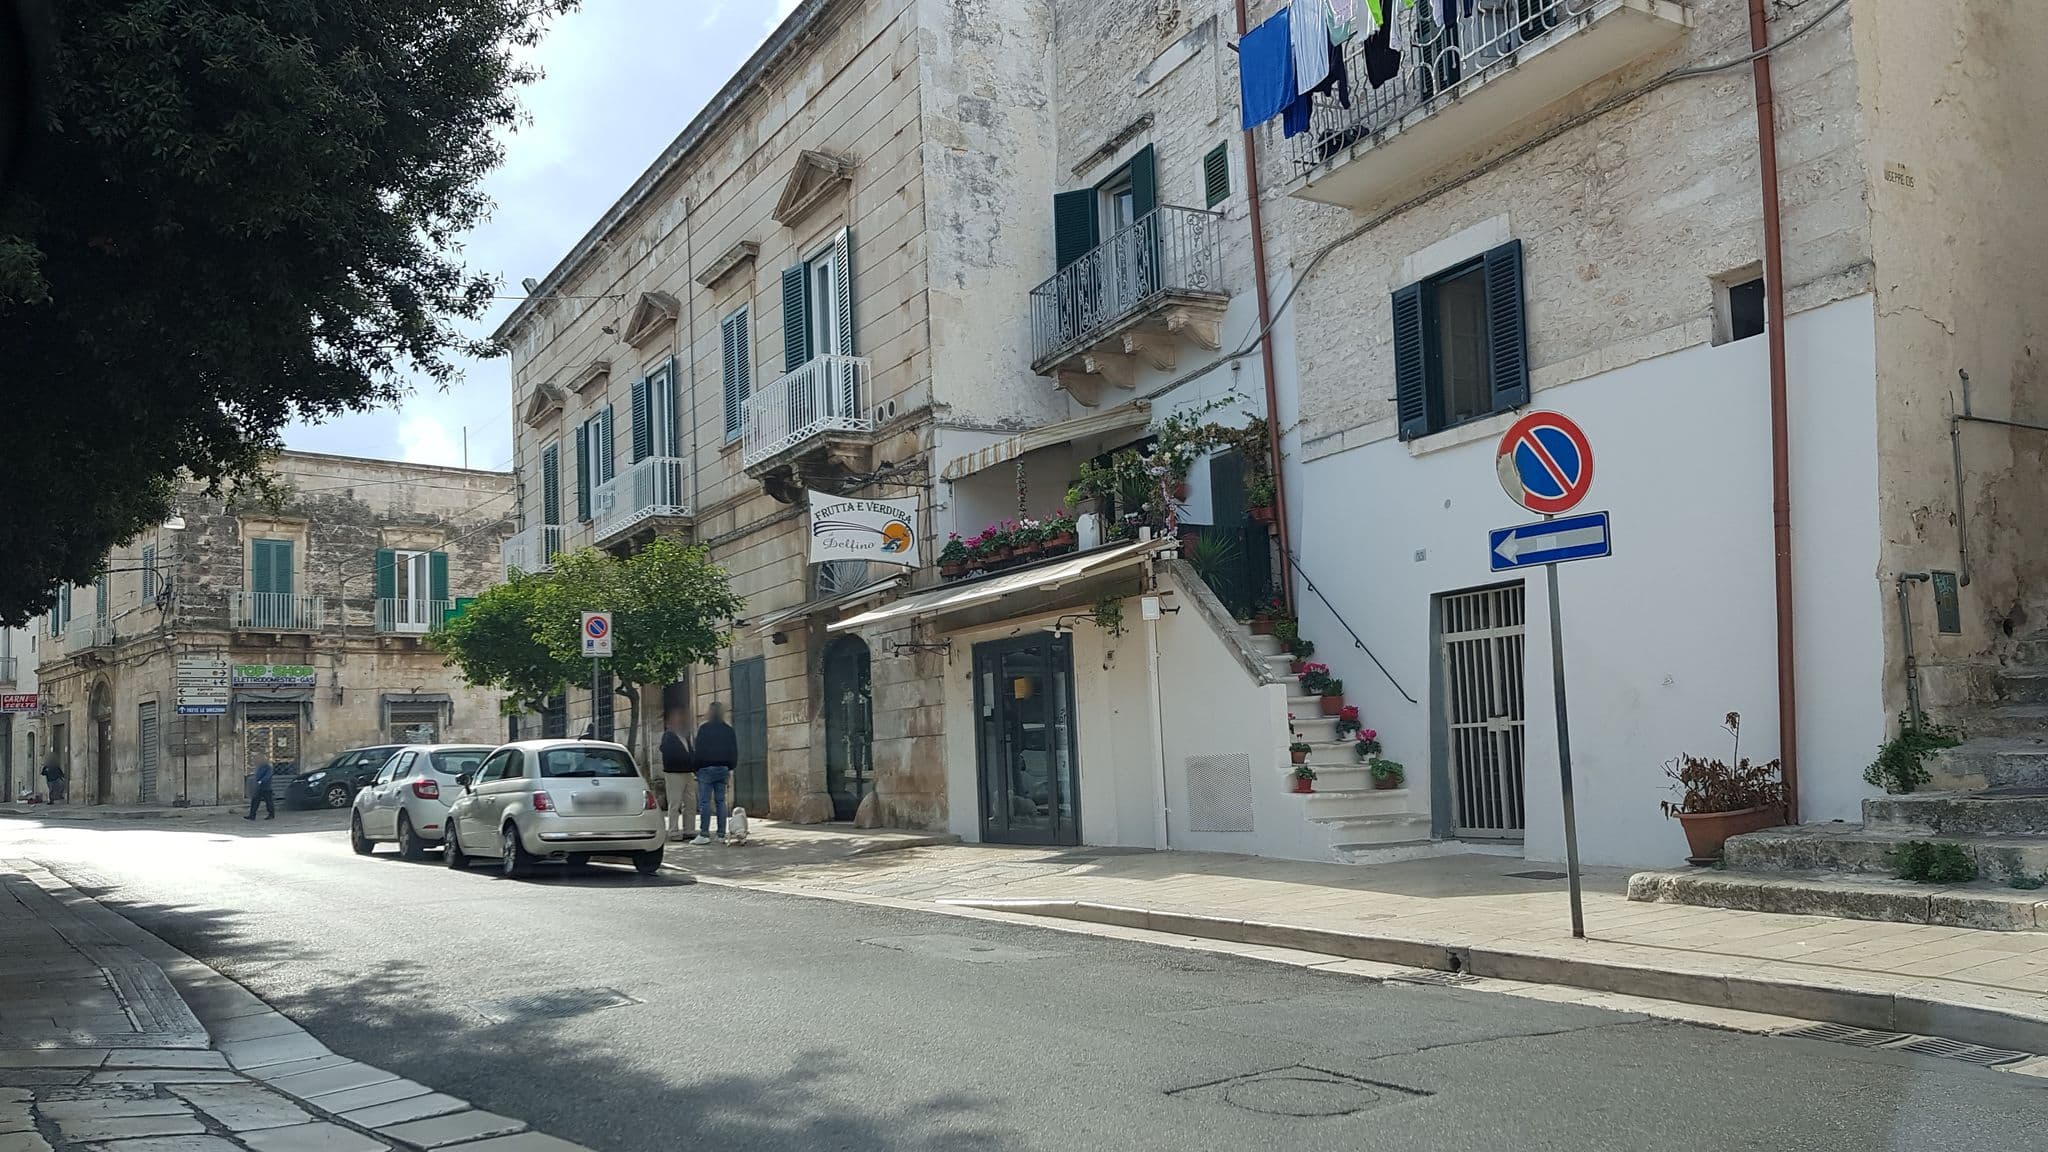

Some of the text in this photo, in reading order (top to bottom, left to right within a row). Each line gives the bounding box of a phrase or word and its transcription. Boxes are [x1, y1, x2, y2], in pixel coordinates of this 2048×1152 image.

[814, 501, 912, 524] FRUTTA E VERDURA
[822, 535, 875, 552] Delfino
